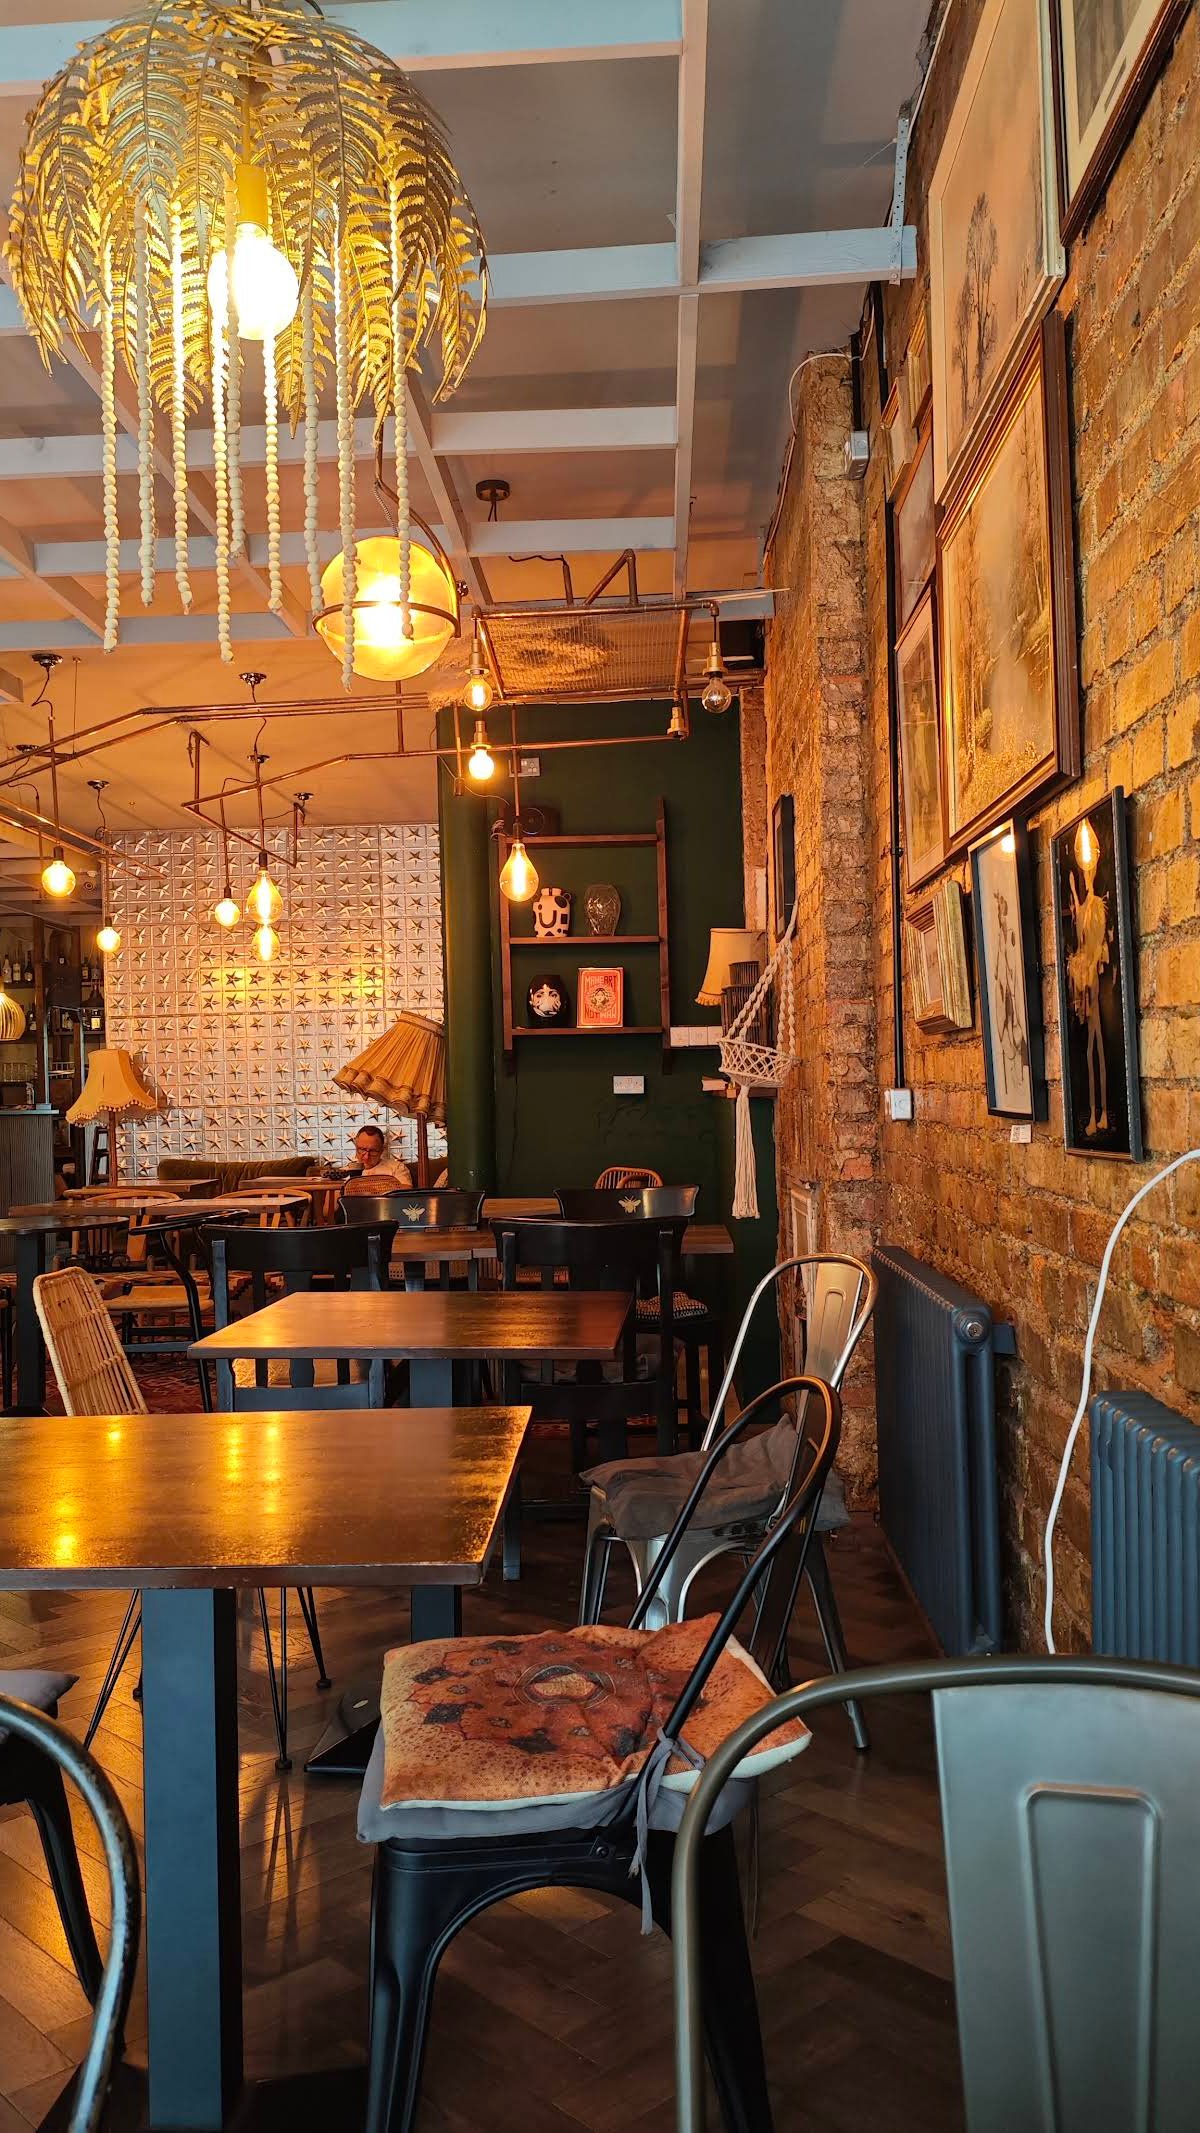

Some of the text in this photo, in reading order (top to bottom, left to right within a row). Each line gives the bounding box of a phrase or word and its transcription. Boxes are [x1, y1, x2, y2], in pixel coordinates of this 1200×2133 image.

[584, 975, 617, 991] MAKE ART
[584, 1003, 617, 1019] NOT WAR
